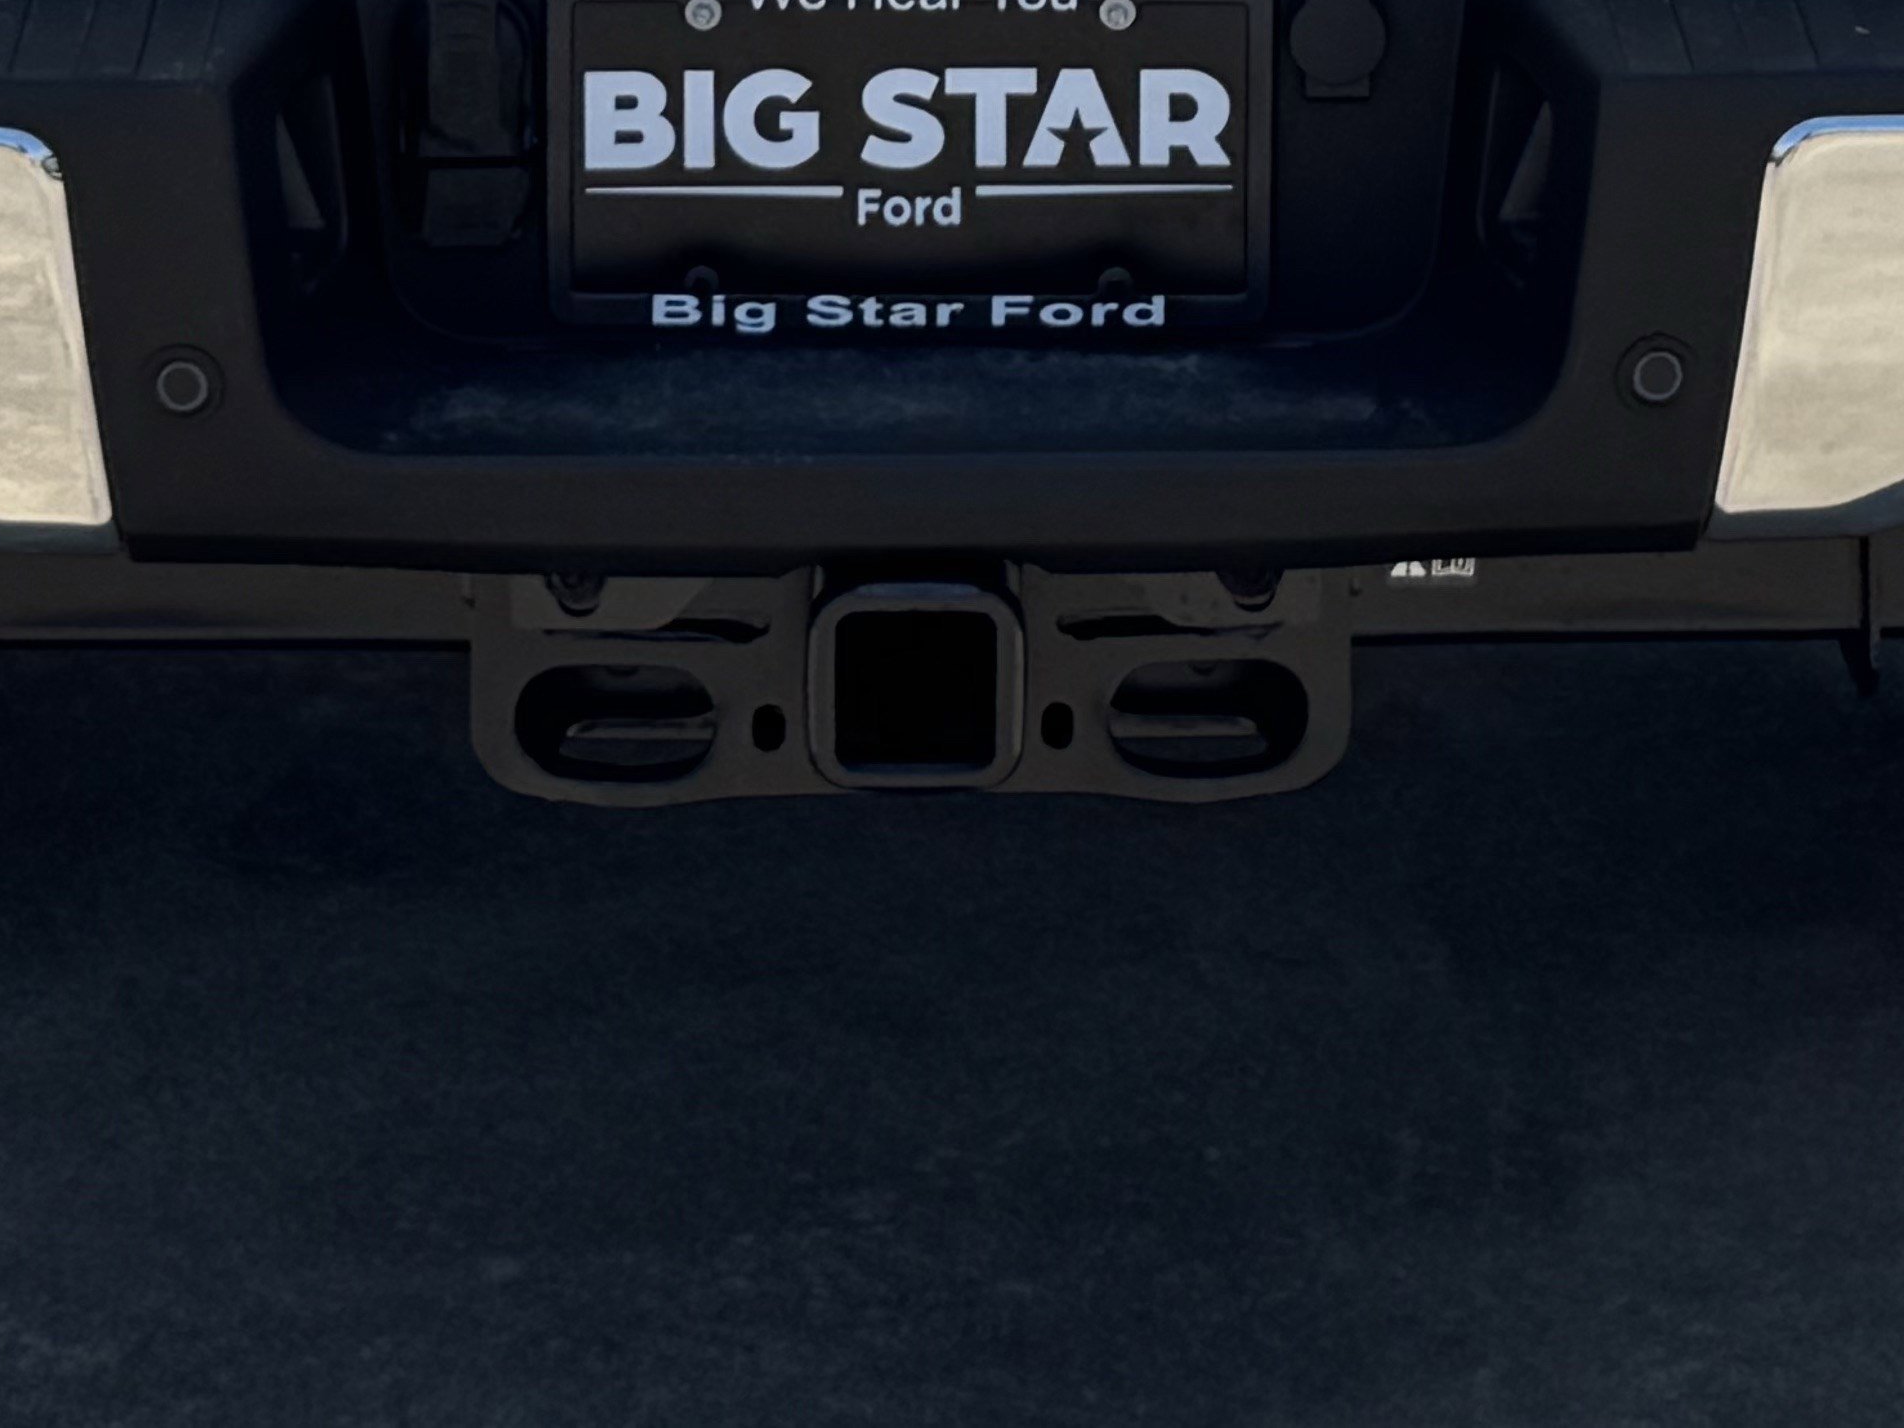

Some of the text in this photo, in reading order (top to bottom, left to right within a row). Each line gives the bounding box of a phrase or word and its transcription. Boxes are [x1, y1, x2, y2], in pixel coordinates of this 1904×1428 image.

[583, 67, 1232, 170] BIG STAR
[856, 187, 962, 227] Ford
[651, 294, 1167, 333] Big Star Ford
